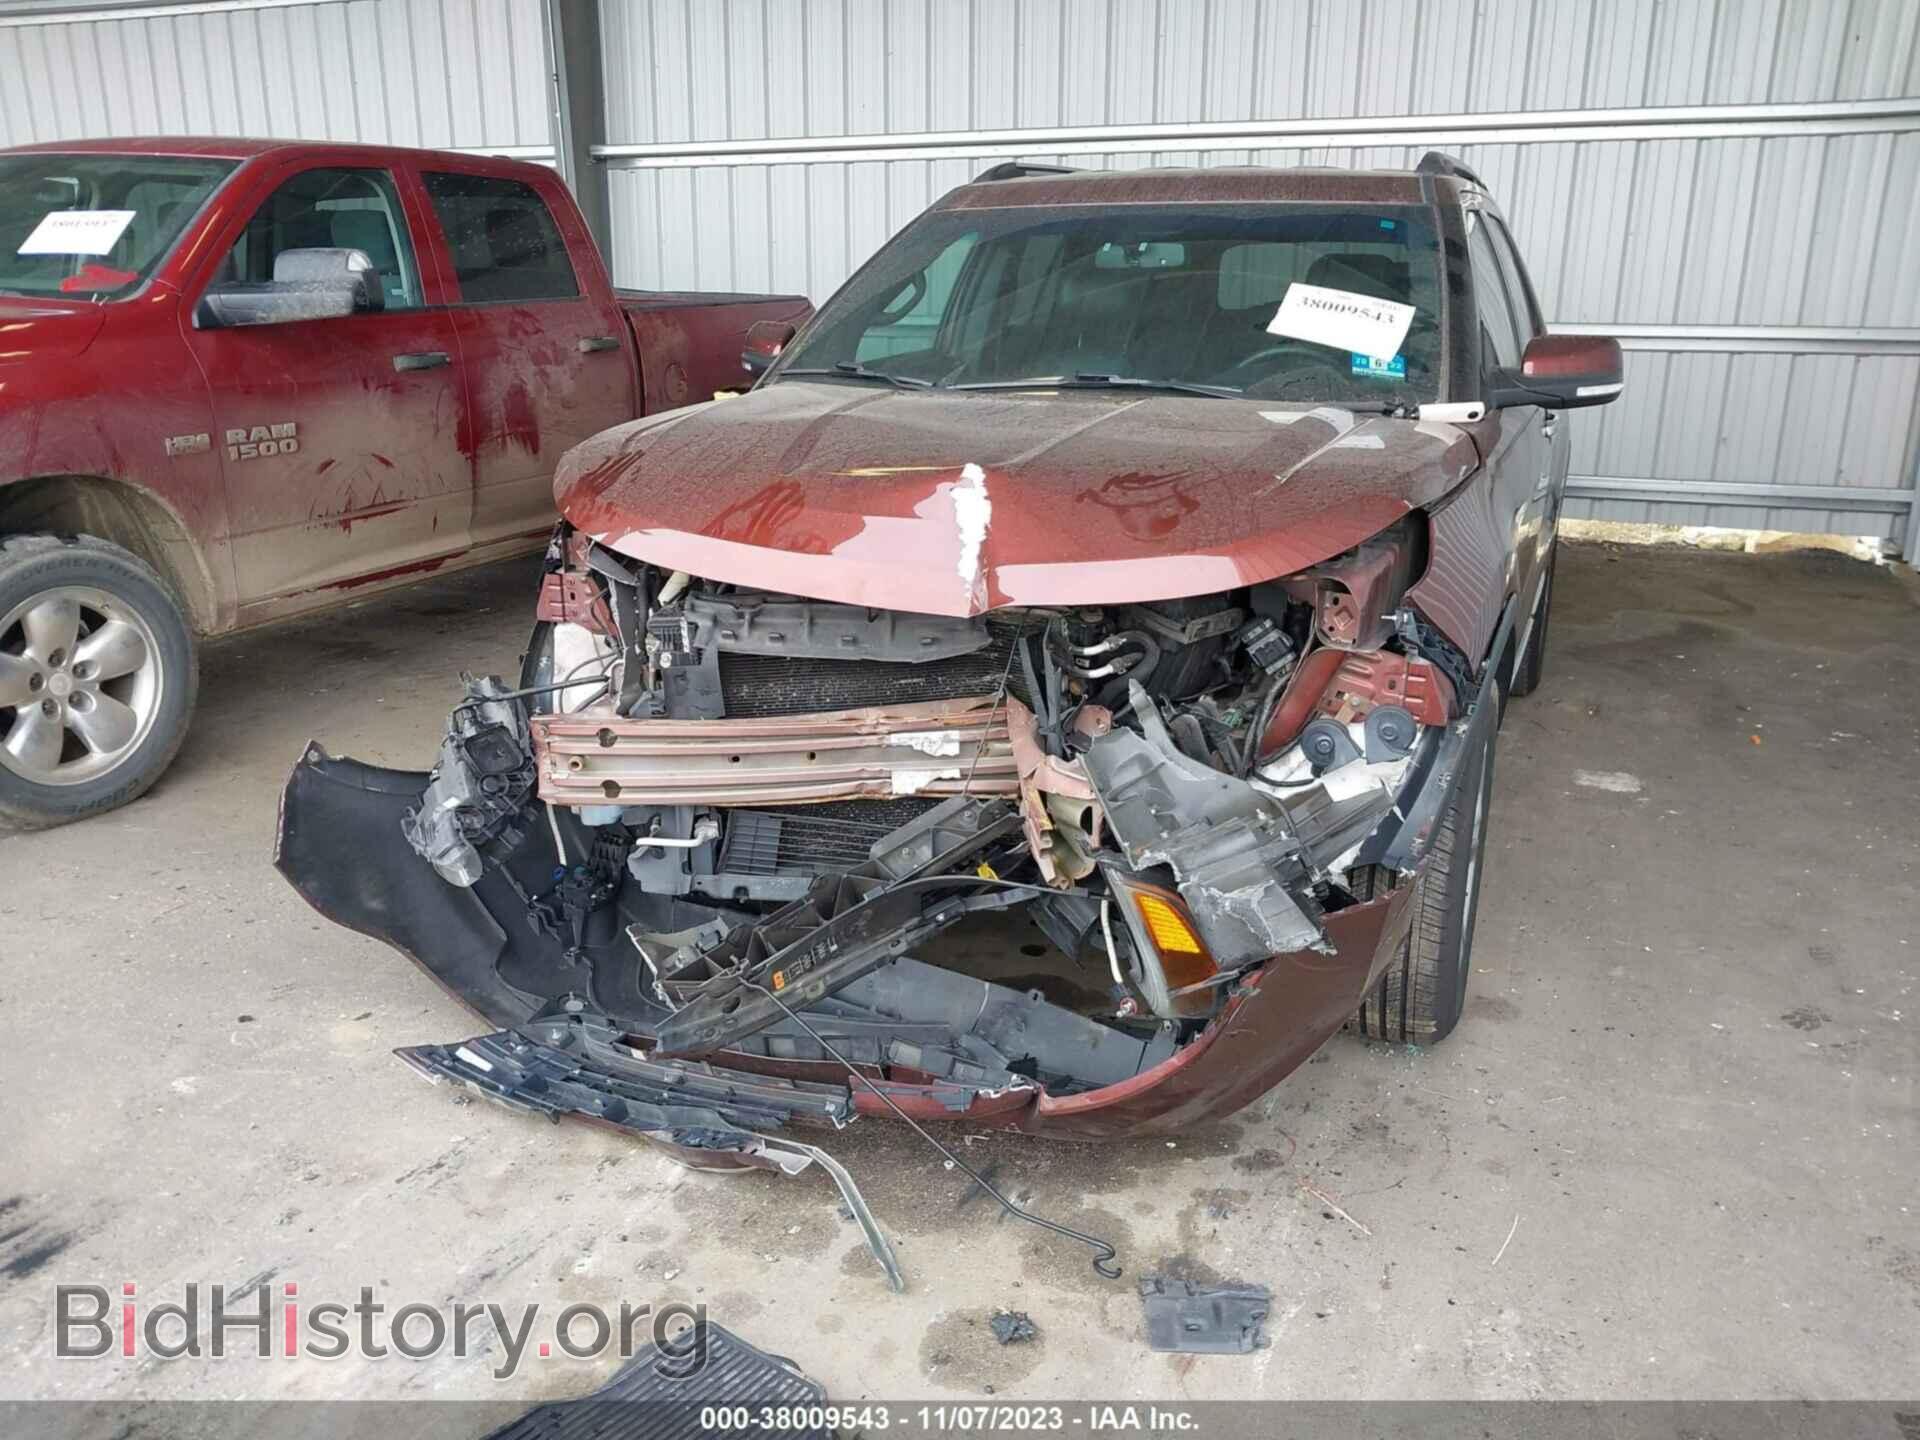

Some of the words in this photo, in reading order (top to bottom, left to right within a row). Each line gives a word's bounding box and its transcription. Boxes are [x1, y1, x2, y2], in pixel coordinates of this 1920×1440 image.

[1297, 296, 1396, 325] 38009543
[226, 422, 297, 444] RAM
[228, 438, 298, 461] 1500
